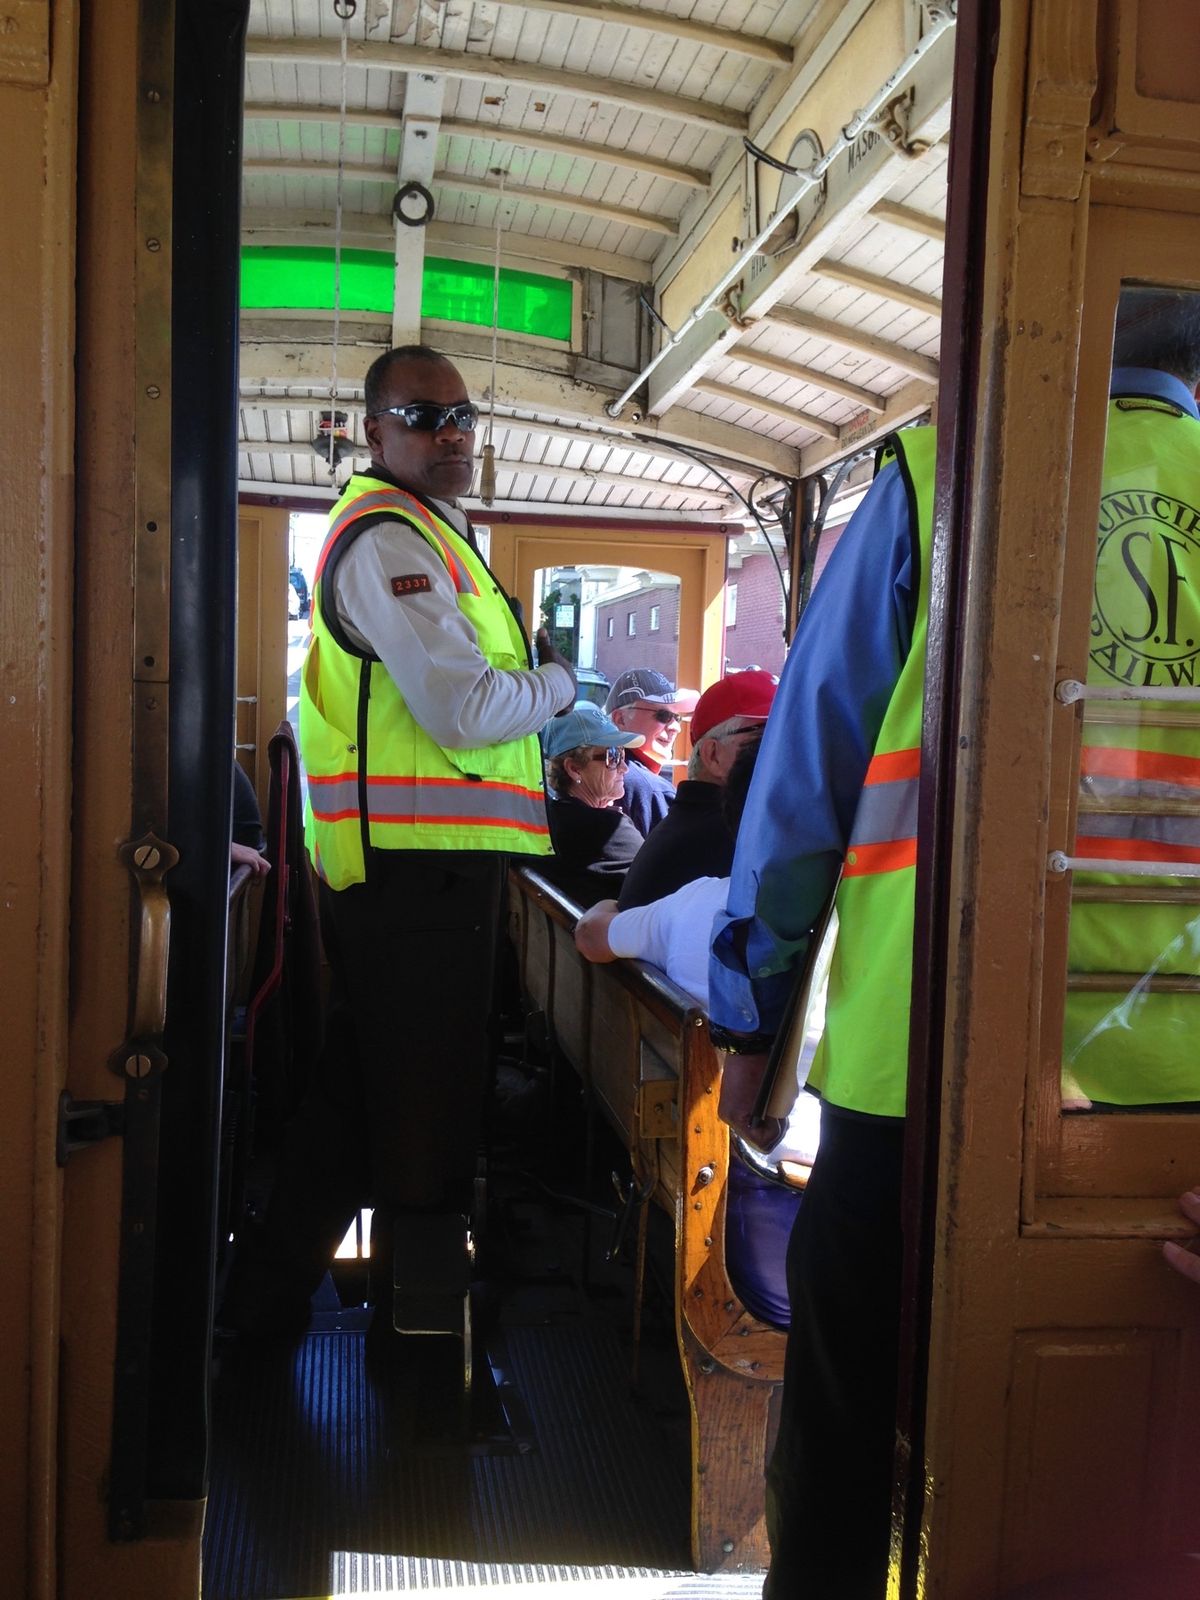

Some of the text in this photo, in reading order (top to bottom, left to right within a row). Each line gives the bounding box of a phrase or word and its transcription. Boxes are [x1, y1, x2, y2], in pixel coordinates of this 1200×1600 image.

[1098, 494, 1200, 544] UNICIP
[396, 578, 427, 591] 2337
[1091, 611, 1200, 687] AILW
